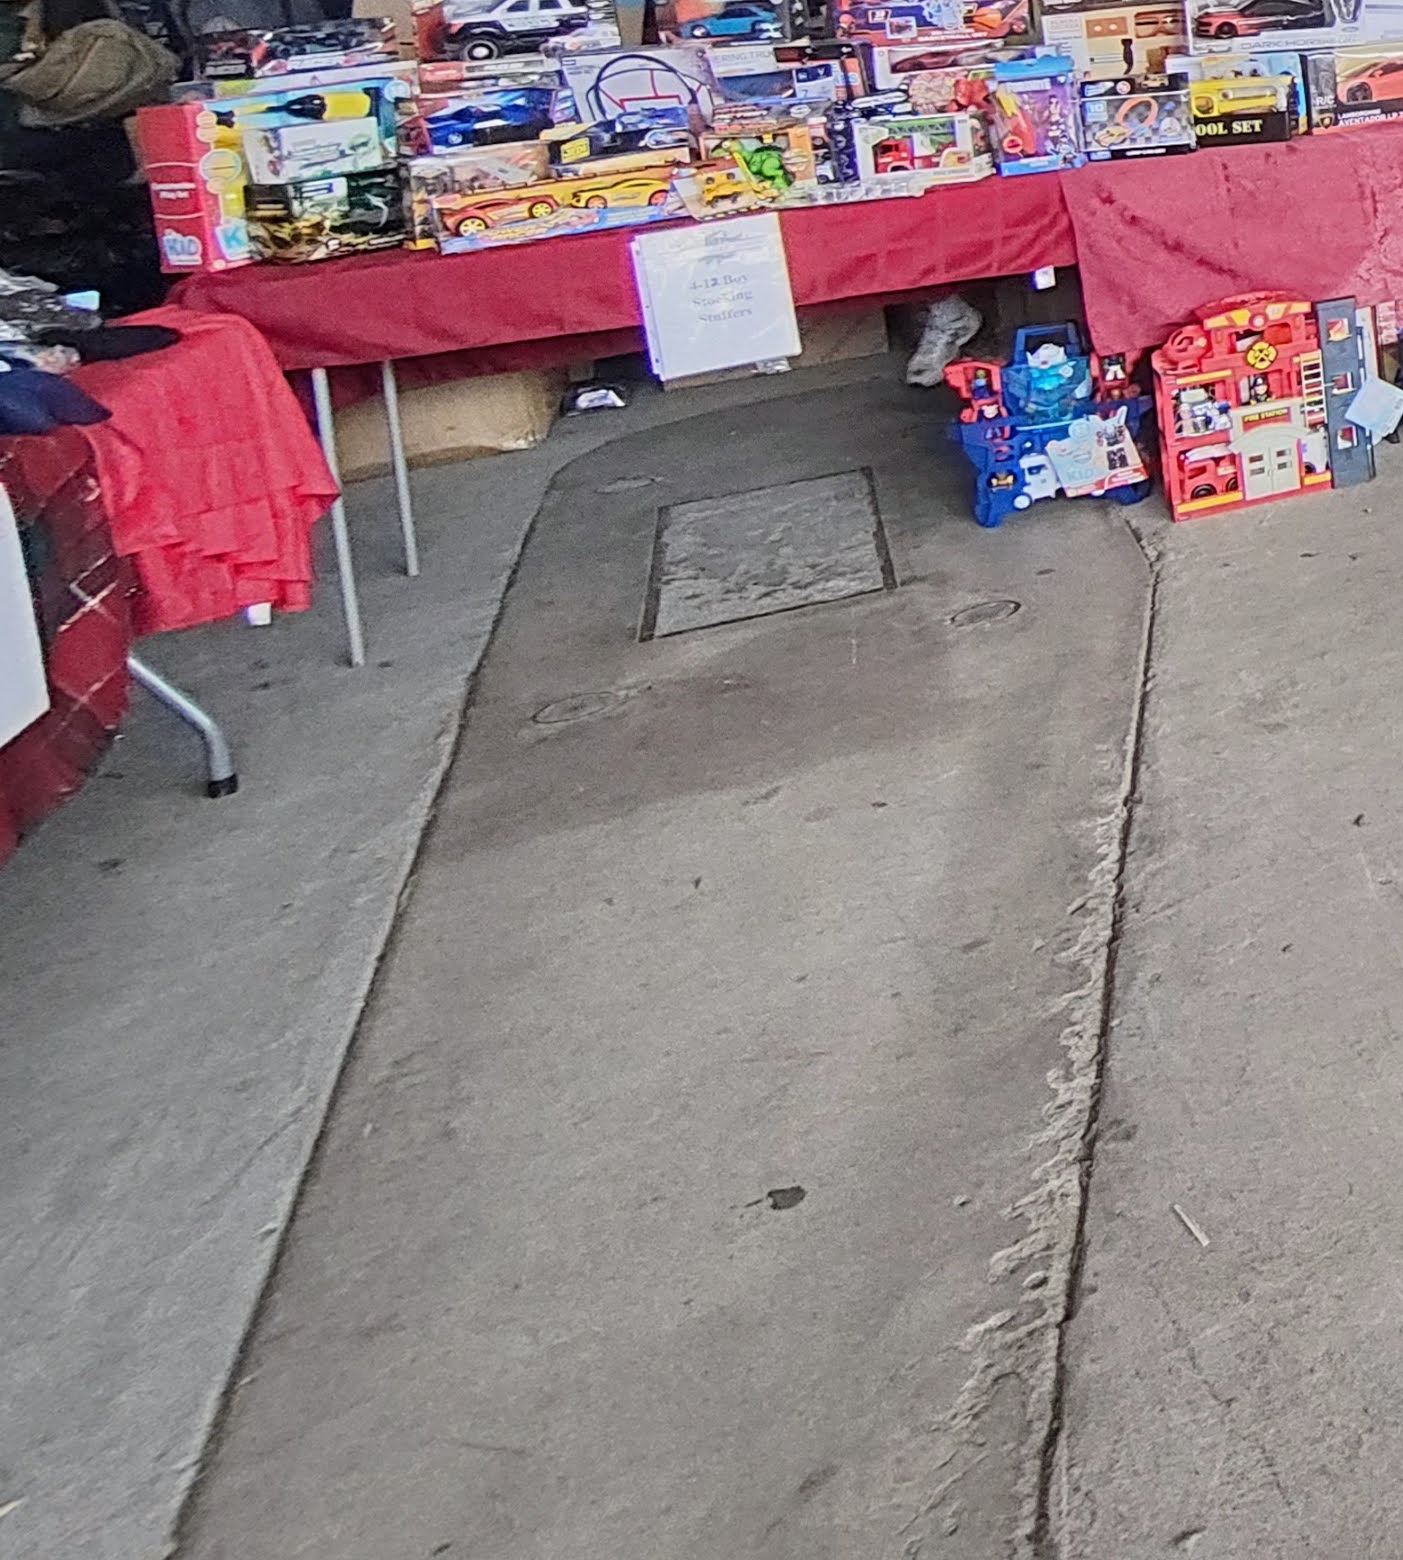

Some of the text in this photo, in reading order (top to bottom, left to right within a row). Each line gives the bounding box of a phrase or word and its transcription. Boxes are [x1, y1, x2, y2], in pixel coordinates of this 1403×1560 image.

[1315, 94, 1335, 107] R/C
[1339, 113, 1387, 127] AVENTADOR
[1387, 112, 1399, 121] LP
[1196, 120, 1263, 136] OOL SET
[1243, 407, 1289, 423] FIRE STATION
